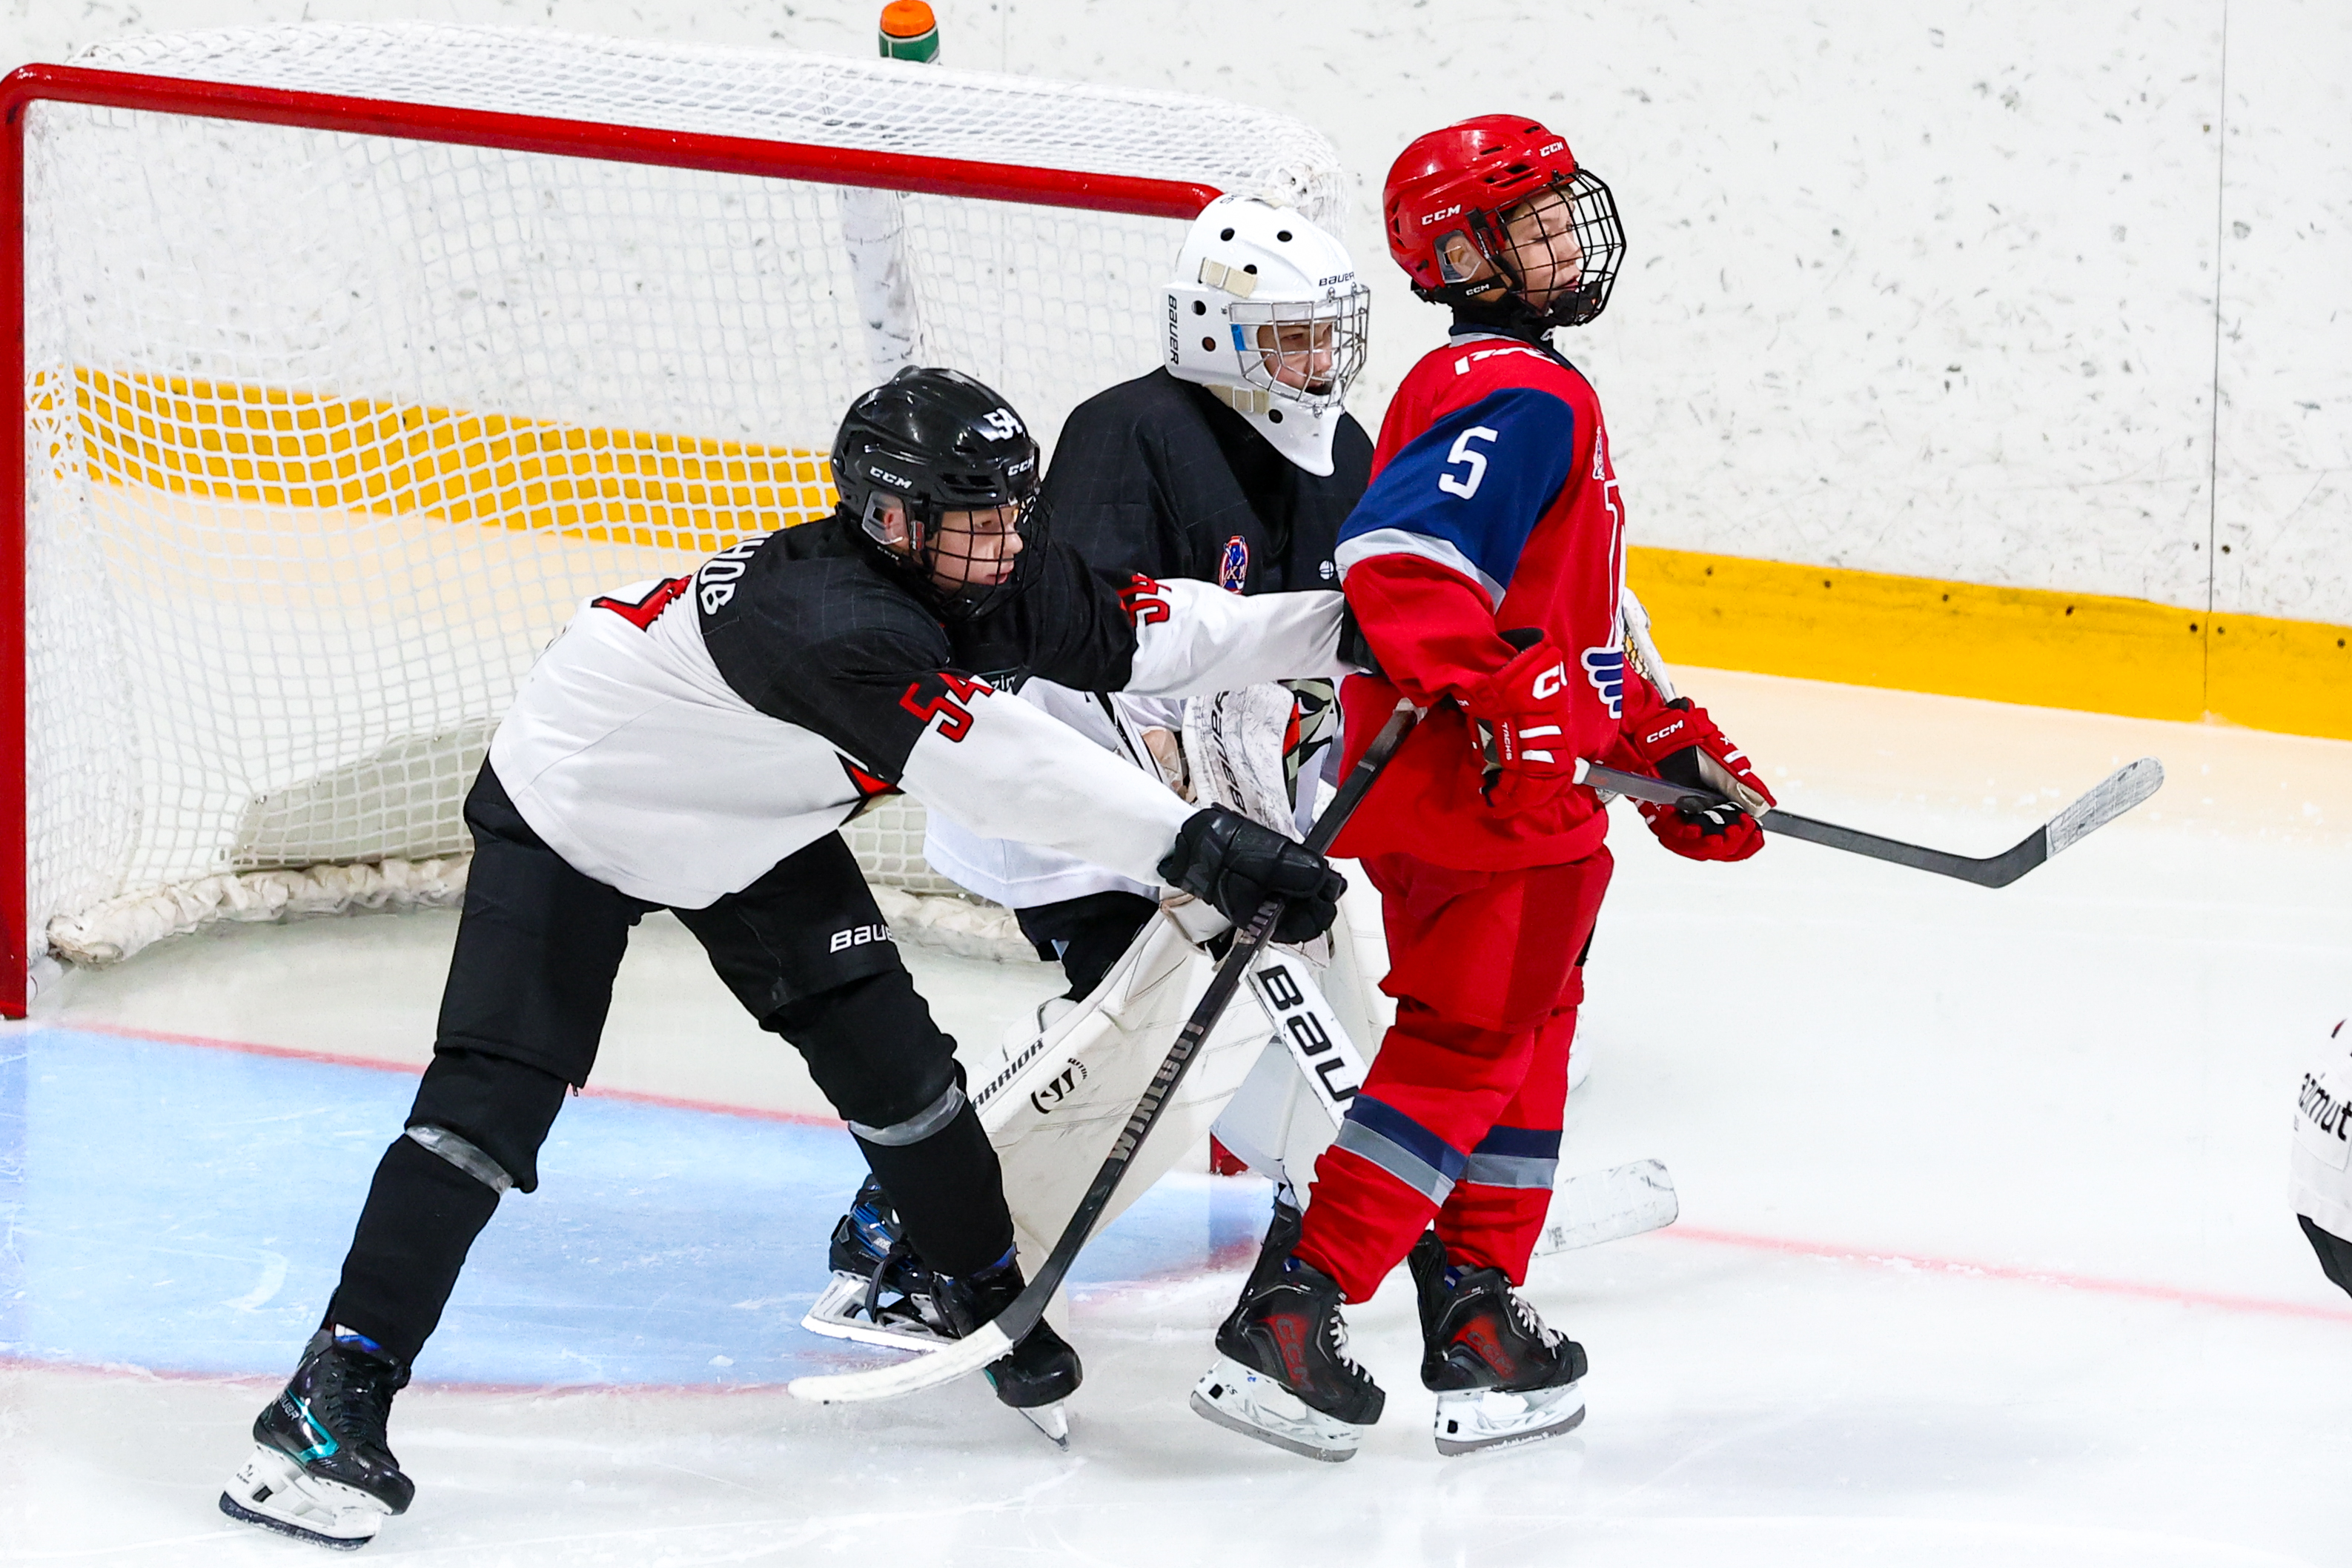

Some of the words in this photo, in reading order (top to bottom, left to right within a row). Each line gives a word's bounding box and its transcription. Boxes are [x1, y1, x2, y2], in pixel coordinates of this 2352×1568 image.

[1540, 142, 1564, 157] CCM
[1421, 205, 1462, 225] CCM
[1319, 271, 1355, 287] BAUER
[1465, 283, 1490, 296] CCM
[1168, 293, 1179, 365] BAUER
[1438, 425, 1498, 500] 5
[869, 465, 913, 489] CCM
[698, 532, 774, 616] НОВ
[899, 672, 995, 743] 54
[1646, 720, 1684, 743] CCM
